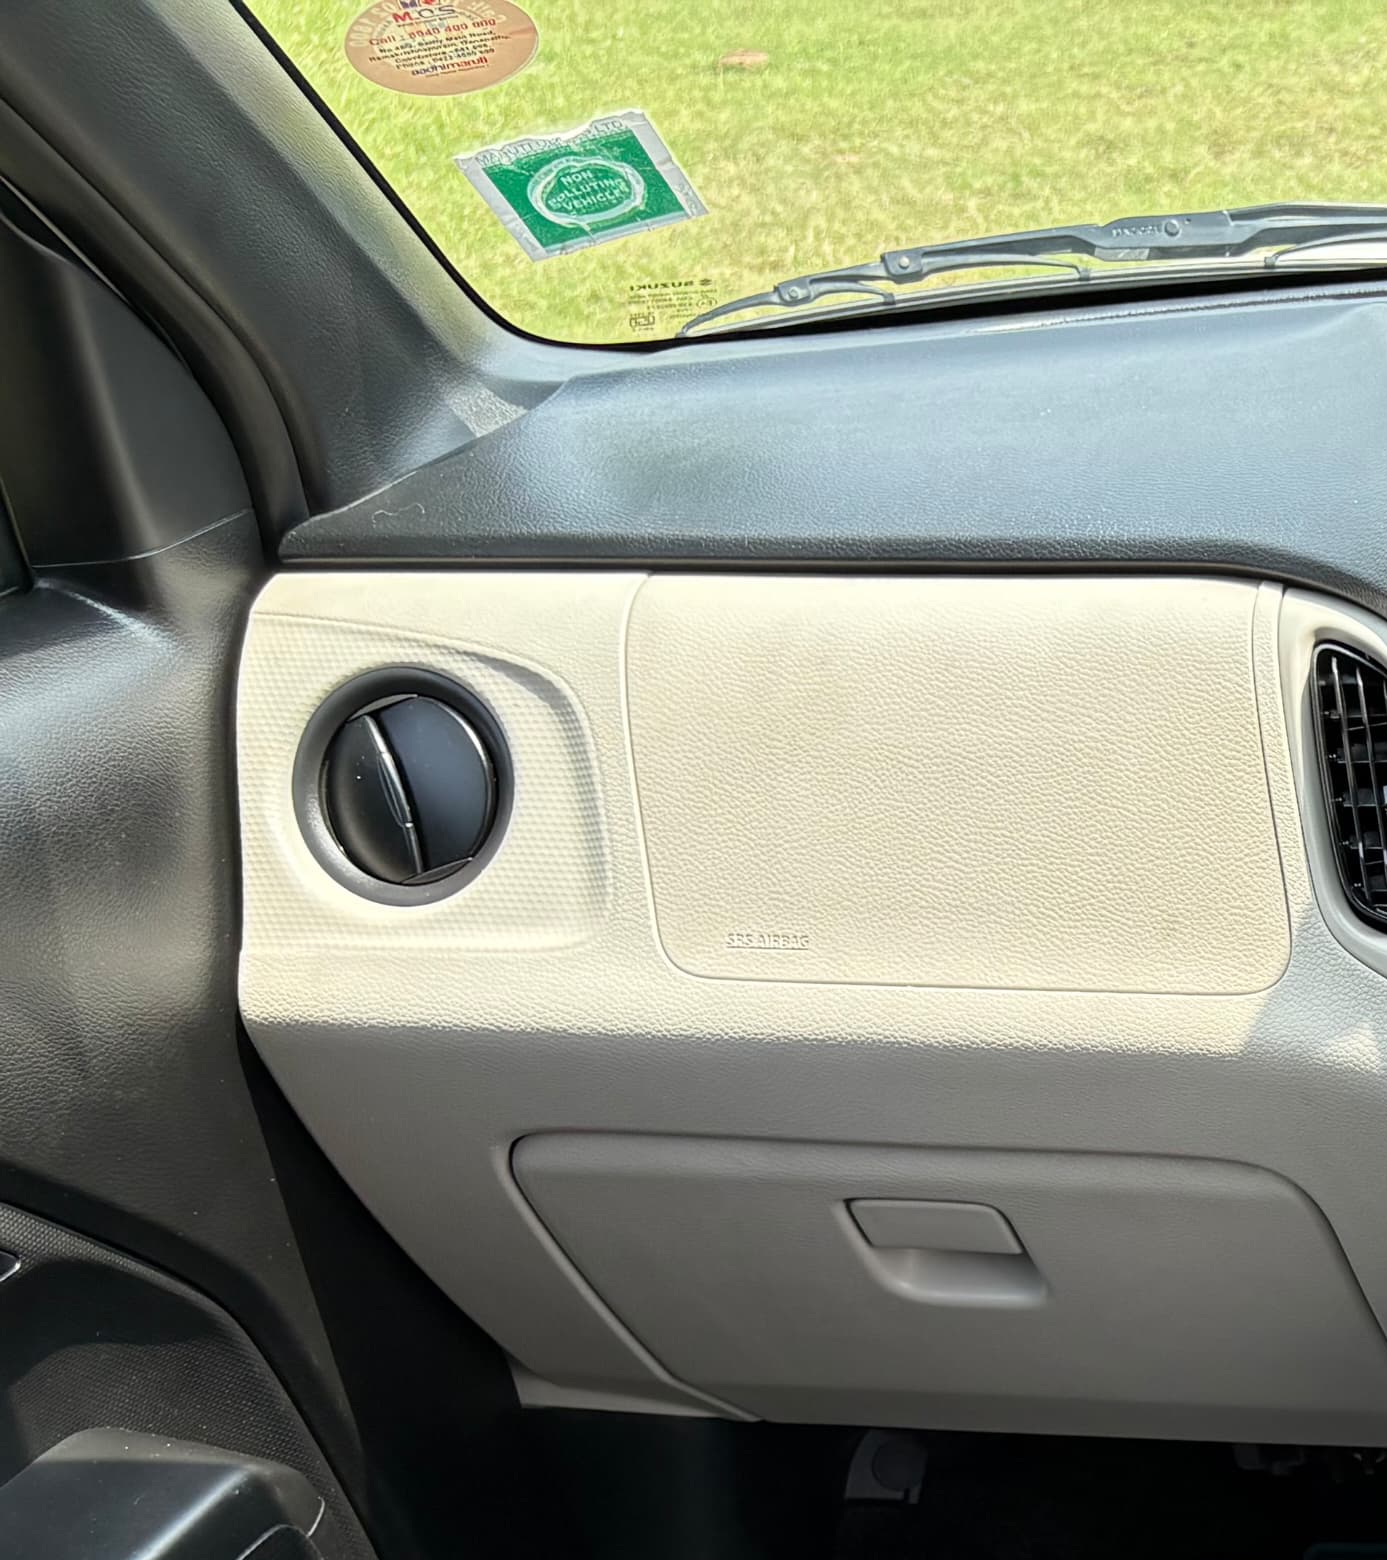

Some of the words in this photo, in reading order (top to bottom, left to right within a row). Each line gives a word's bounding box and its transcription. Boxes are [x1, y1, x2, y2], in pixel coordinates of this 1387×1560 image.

[560, 169, 593, 186] NON
[726, 932, 754, 947] SRS
[757, 933, 810, 948] AIRBAG
